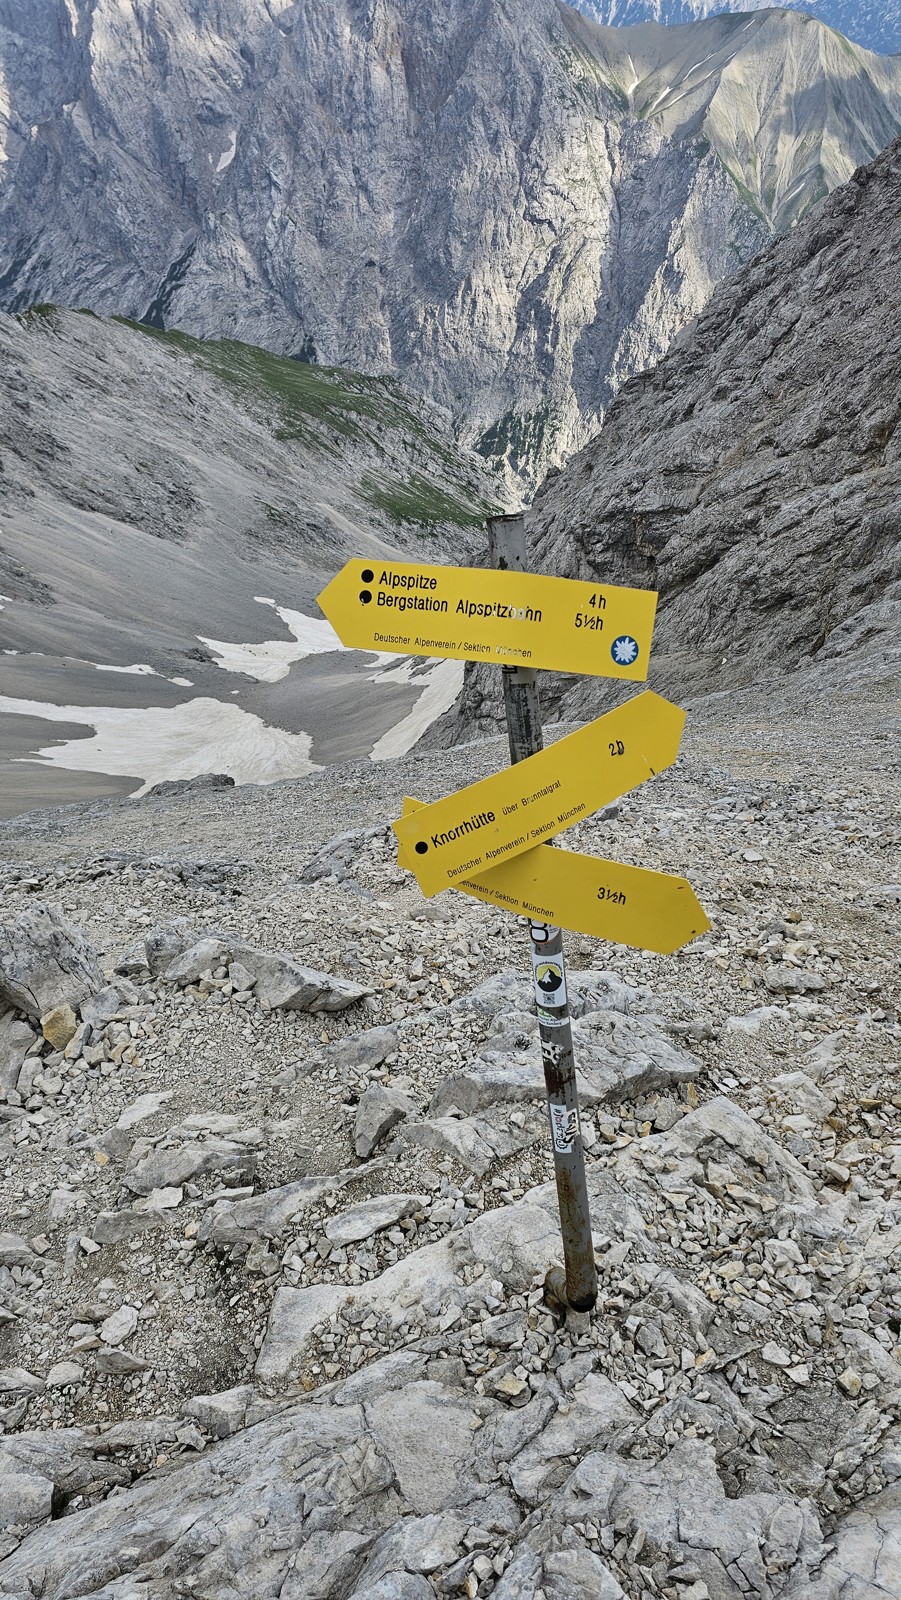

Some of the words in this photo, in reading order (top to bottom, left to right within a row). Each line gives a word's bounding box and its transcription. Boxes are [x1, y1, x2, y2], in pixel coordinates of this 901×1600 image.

[379, 571, 437, 590] Alpspitze
[377, 591, 448, 612] Bergstation
[373, 632, 410, 645] Deutscher
[414, 637, 456, 650] Alpenverein
[463, 642, 491, 653] Sektion
[430, 811, 496, 849] Knorrhütte
[502, 802, 519, 816] über
[521, 780, 562, 807] Brunntalgrat
[447, 857, 482, 878] Deutscher
[485, 837, 526, 860] Alpenverein
[530, 820, 556, 838] Sektion
[557, 803, 586, 823] München
[460, 880, 489, 894] enverein
[495, 891, 519, 906] Sektion
[522, 901, 554, 918] München
